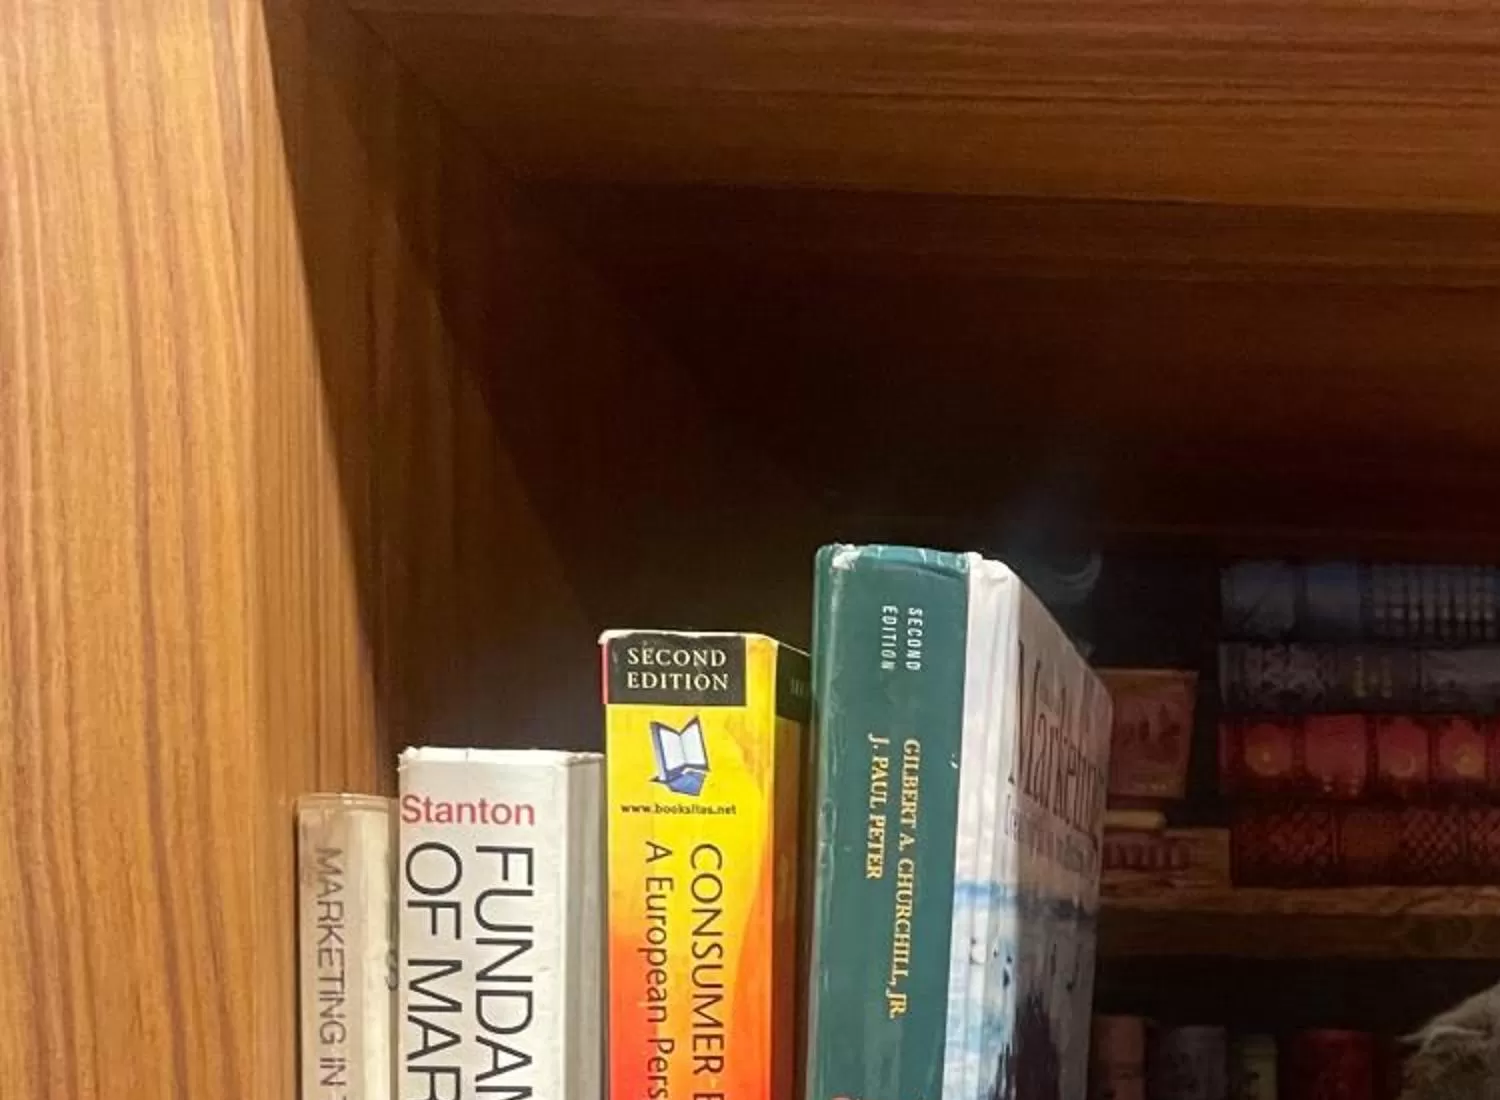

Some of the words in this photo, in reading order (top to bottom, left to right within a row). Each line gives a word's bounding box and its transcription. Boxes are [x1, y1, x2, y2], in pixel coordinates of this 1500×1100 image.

[627, 648, 726, 667] SECOND
[881, 605, 899, 670] EDITION
[905, 607, 923, 671] SECOND
[627, 672, 729, 691] EDITION
[868, 734, 891, 750] J.
[401, 795, 535, 826] Stanton
[870, 755, 889, 811] PAUL
[901, 739, 921, 829] GILBERT
[645, 841, 673, 864] A
[866, 815, 886, 880] PETER
[898, 834, 917, 852] A.
[405, 842, 463, 940] OF
[315, 847, 347, 1045] MARKETING
[638, 876, 674, 1023] European
[889, 857, 915, 988] CHURCHILL,
[690, 843, 725, 1075] CONSUMER
[885, 987, 907, 1019] JR.
[319, 1058, 347, 1086] IN
